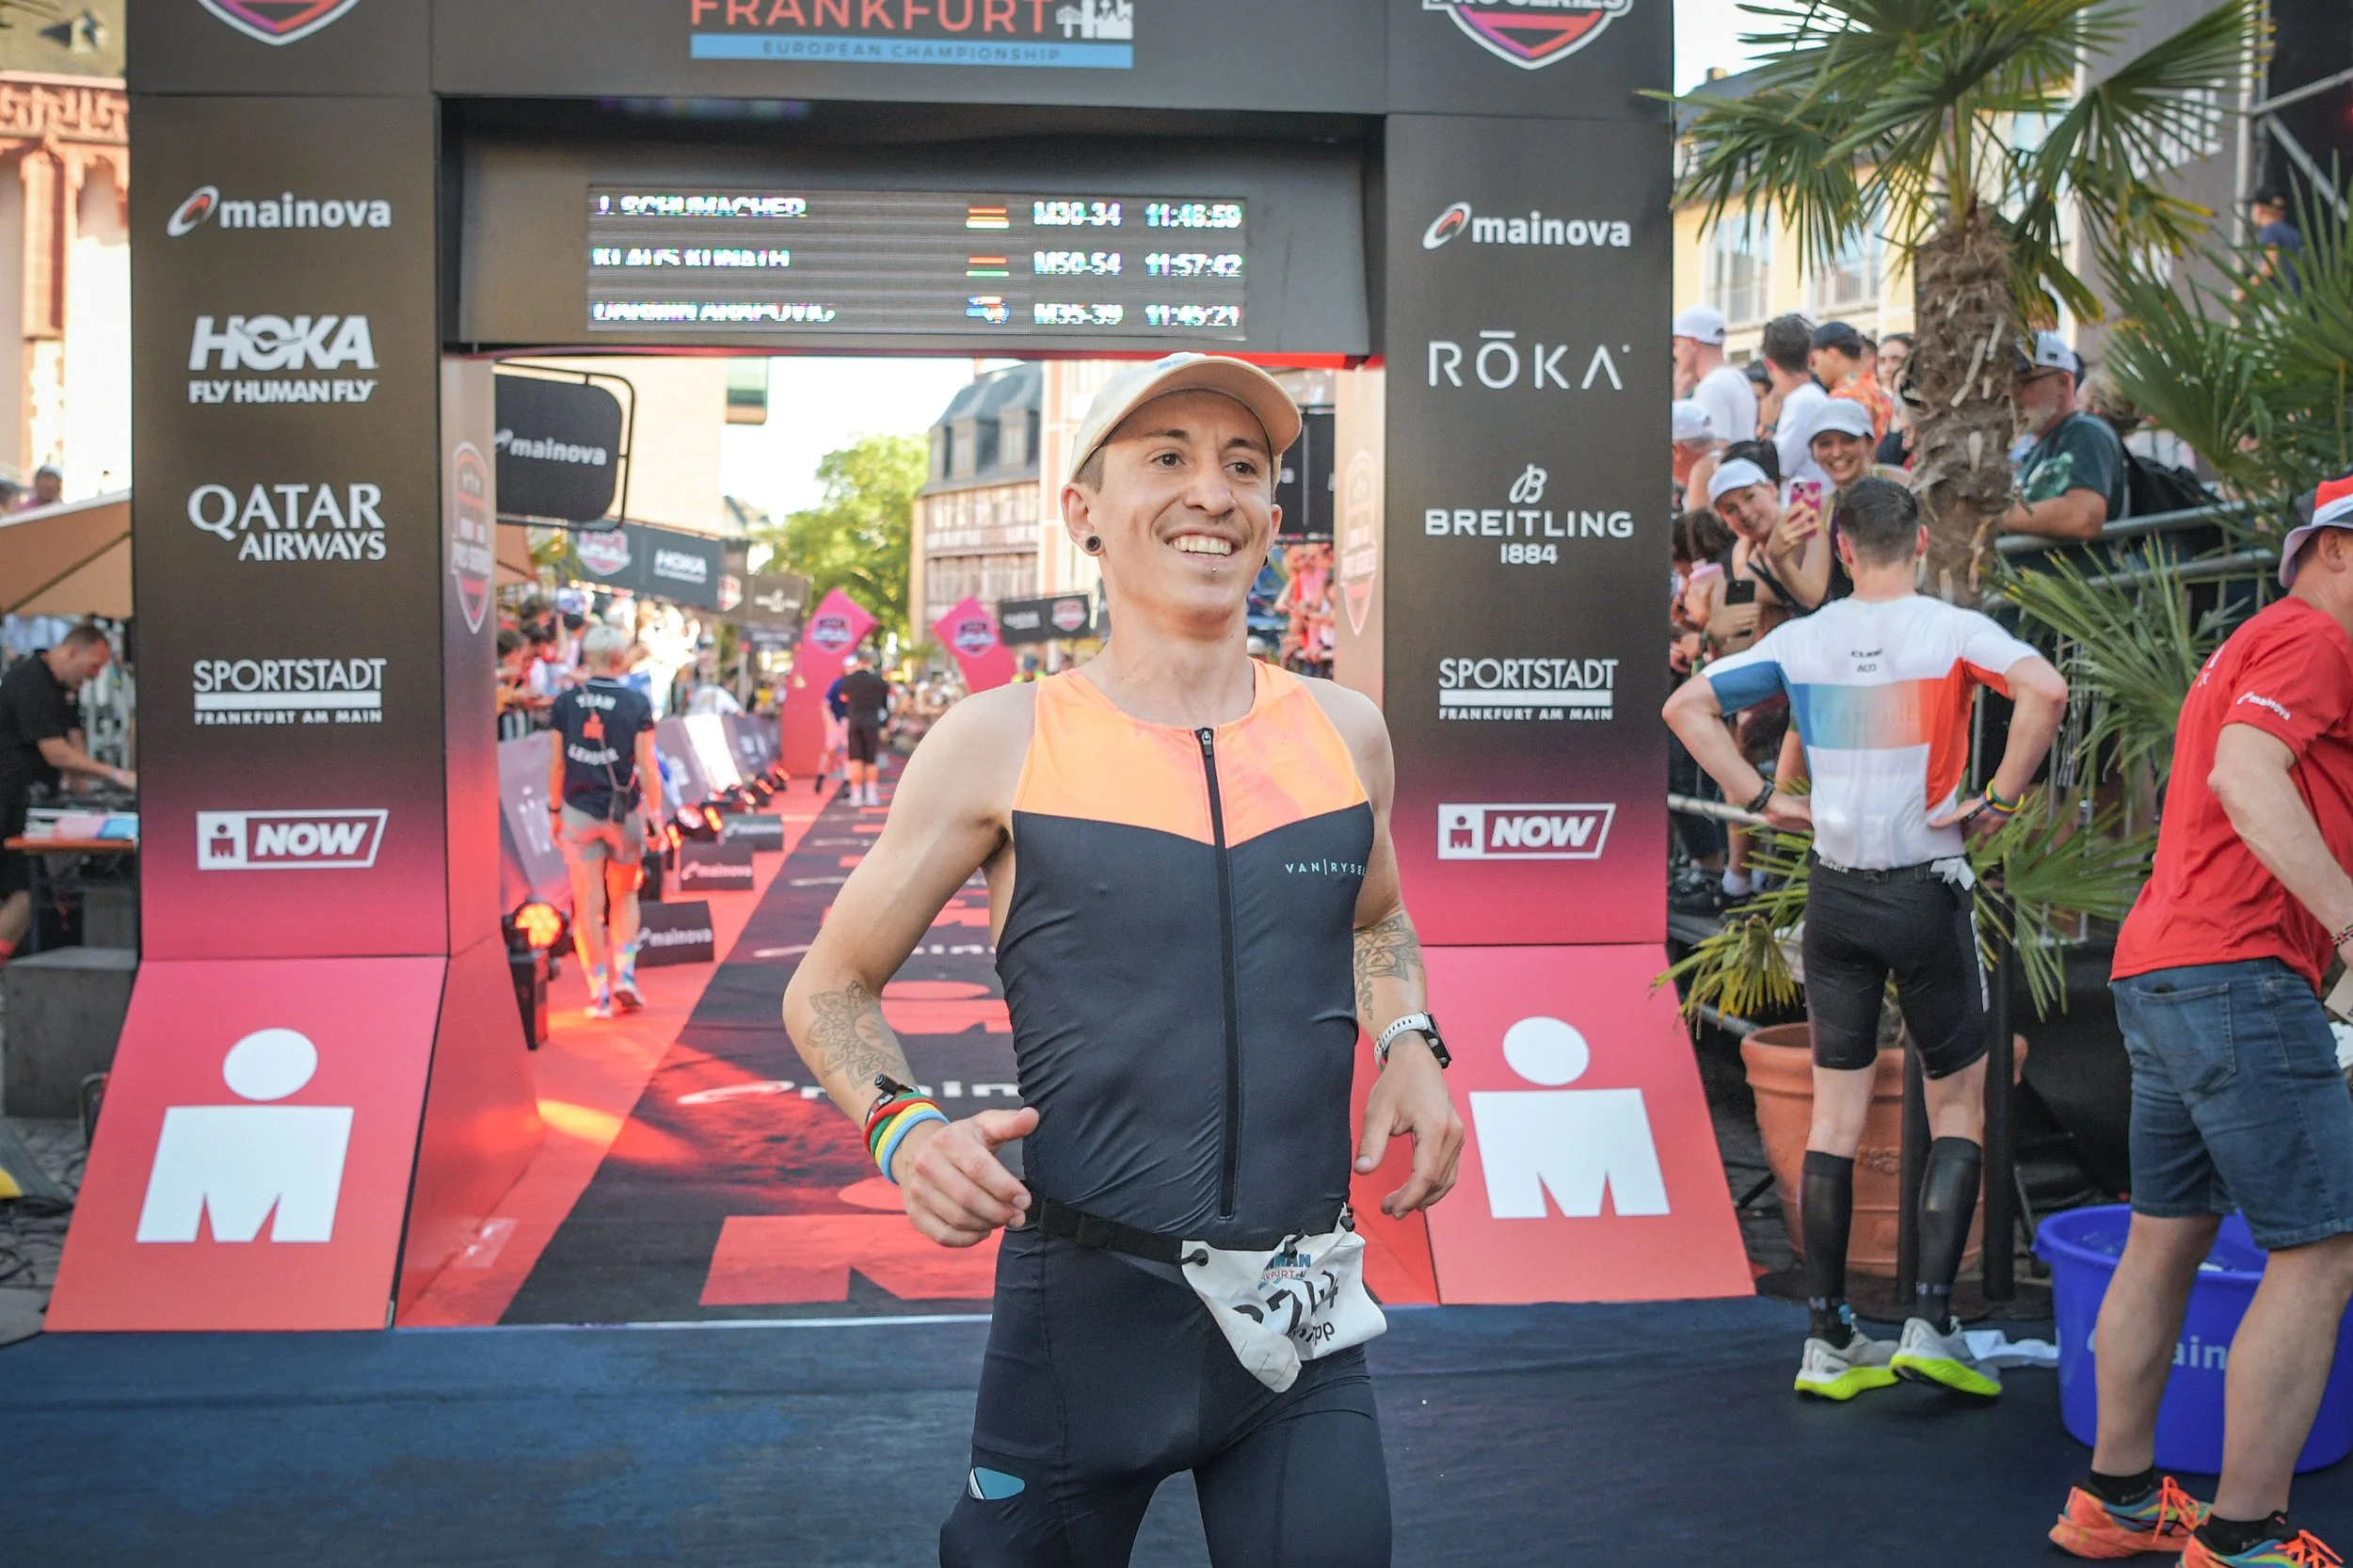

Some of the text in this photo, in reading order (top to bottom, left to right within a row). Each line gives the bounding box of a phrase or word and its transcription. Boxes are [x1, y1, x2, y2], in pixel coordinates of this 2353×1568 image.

[690, 0, 1054, 34] FRANKFURT
[762, 40, 1062, 62] EUROPEAN CHAMPIONSHIP
[219, 192, 392, 229] mainova
[1472, 210, 1631, 248] mainova
[1033, 251, 1123, 275] M50-54
[188, 314, 377, 371] HOKA
[189, 378, 376, 404] FLY HUMAN FLY
[509, 436, 607, 466] mainova
[187, 483, 385, 540] QATAR
[1425, 508, 1634, 538] BREITLING
[238, 532, 387, 561] AIRWAYS
[1500, 542, 1559, 565] 1884
[193, 658, 388, 692] SPORTSTADT
[1438, 658, 1619, 689] SPORTSTADT
[194, 710, 383, 725] FRANKFURT AM MAIN
[1438, 708, 1613, 721] FRANKFURT AM MAIN
[254, 823, 369, 856] NOW
[1490, 816, 1599, 847] NOW
[649, 927, 713, 947] mainova
